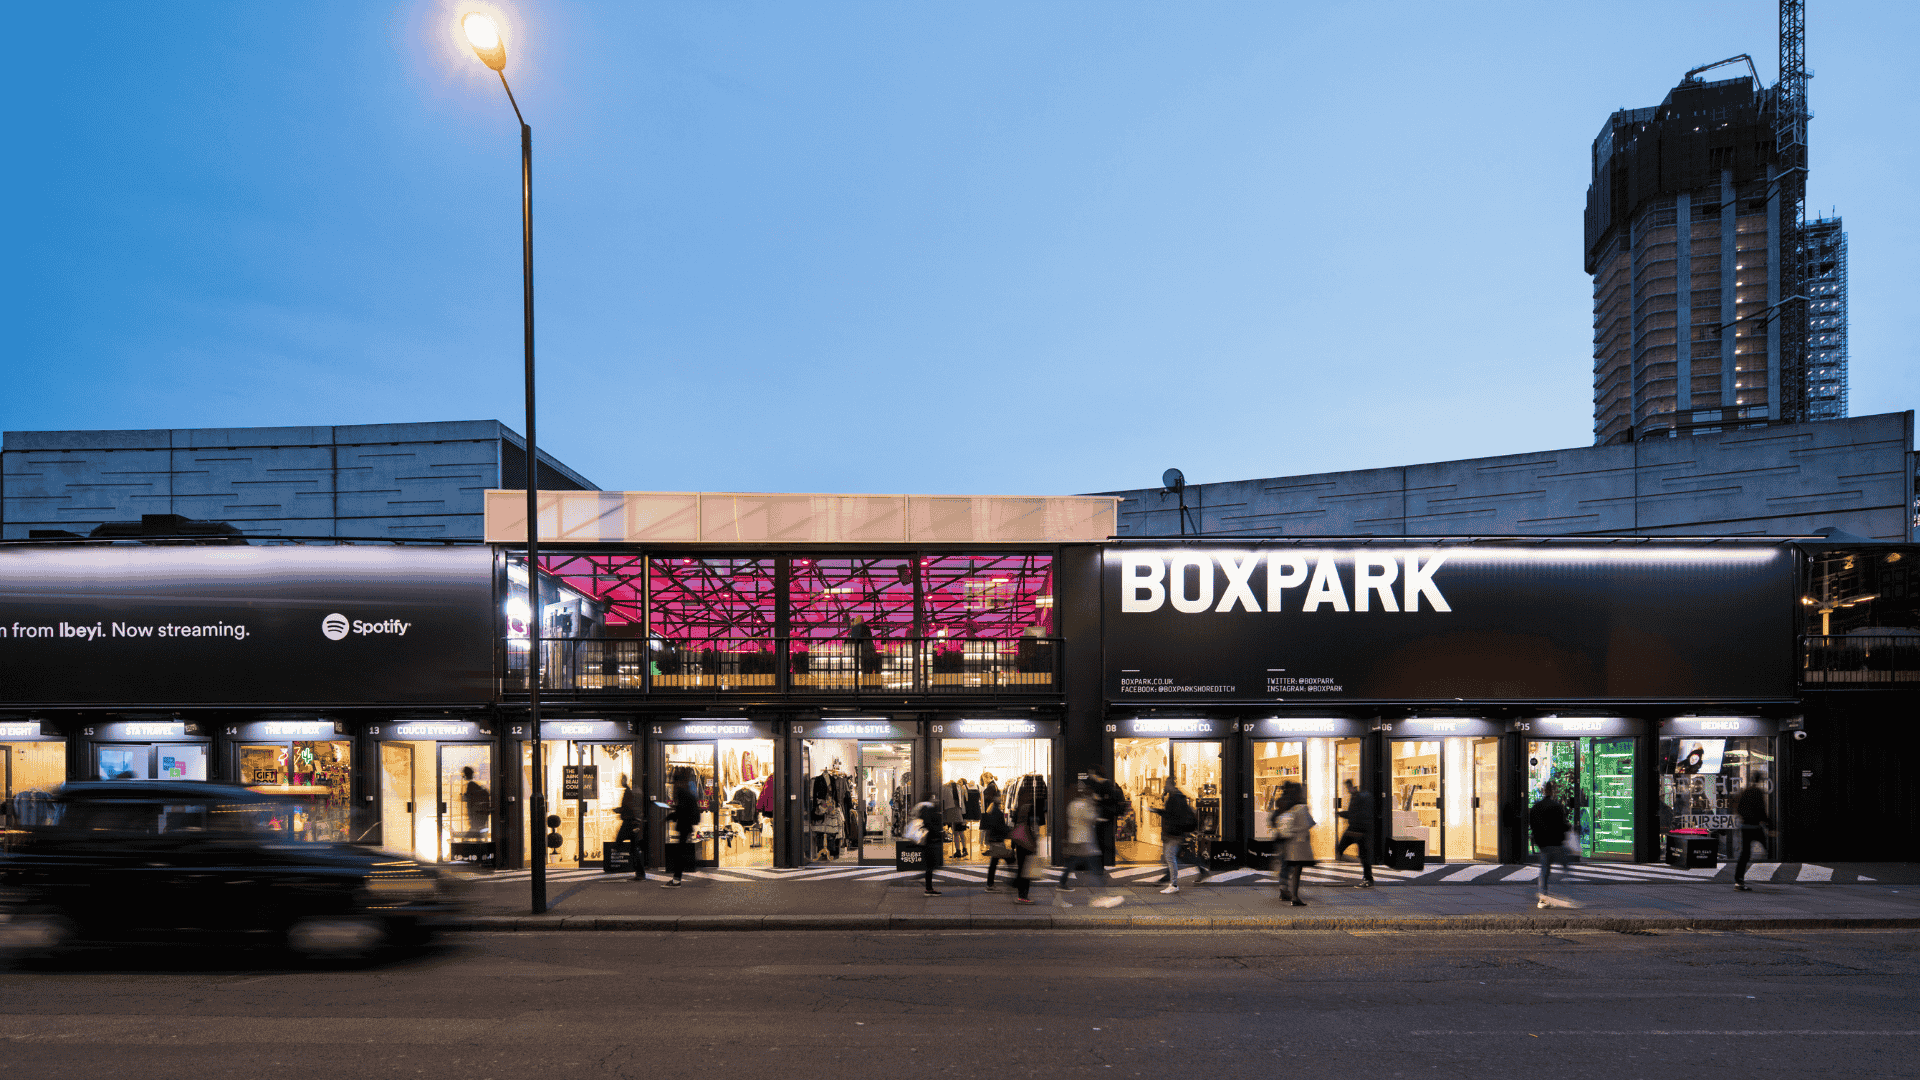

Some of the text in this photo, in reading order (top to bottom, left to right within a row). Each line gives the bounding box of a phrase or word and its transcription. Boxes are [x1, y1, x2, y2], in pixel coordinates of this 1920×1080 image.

[1121, 550, 1452, 613] BOXPARK
[12, 621, 54, 638] from
[59, 621, 106, 641] Ibeyi.
[112, 621, 153, 638] Now
[158, 620, 250, 641] streaming.
[352, 618, 409, 636] Spotify
[1267, 677, 1334, 685] TWITTER: @BOXPARK
[1121, 685, 1157, 693] FACEBOOK:
[1266, 685, 1343, 693] INSTAGRAM: @BOXPARK
[83, 727, 95, 736] 15
[226, 726, 238, 735] 14
[369, 726, 380, 735] 13
[511, 726, 522, 735] 12
[652, 726, 663, 734] 11
[685, 725, 749, 735] NORDIC POETRY
[792, 726, 803, 734] 10
[827, 725, 855, 734] SUGAR
[864, 725, 890, 734] STYLE
[932, 725, 943, 734] 09
[1105, 724, 1117, 733] 08
[1198, 723, 1213, 732] CO.
[1243, 723, 1255, 732] 07
[1381, 723, 1392, 731] 06
[256, 771, 275, 779] GIFT
